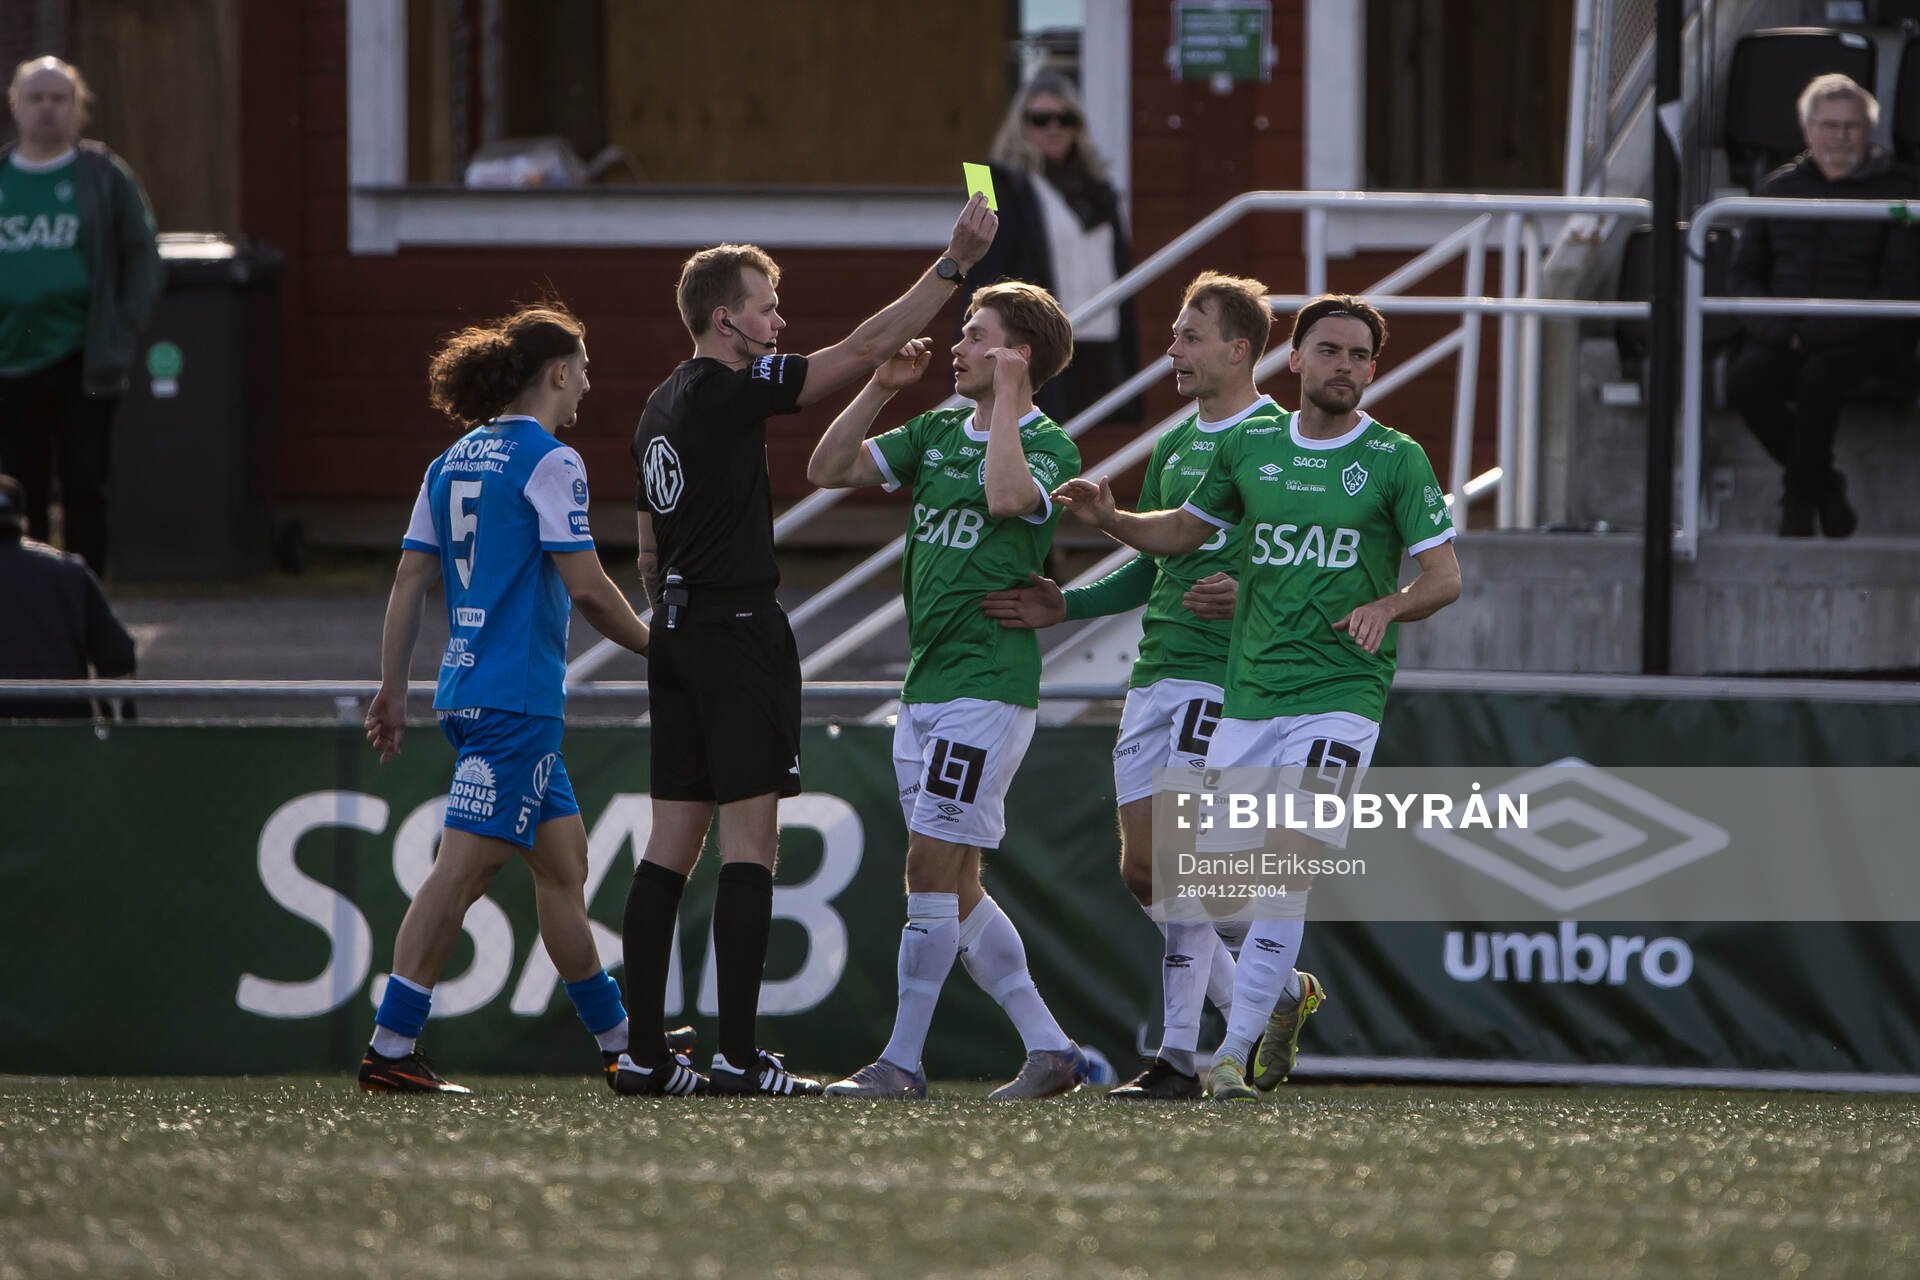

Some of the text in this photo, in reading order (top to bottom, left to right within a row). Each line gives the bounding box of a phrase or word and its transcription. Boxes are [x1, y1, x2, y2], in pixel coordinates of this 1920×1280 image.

[645, 442, 679, 508] MG
[1293, 456, 1327, 469] SACCI
[450, 480, 482, 591] 5
[1252, 523, 1361, 568] SSAB
[515, 806, 532, 834] 5
[937, 814, 960, 824] umbro
[1443, 921, 1694, 988] umbro
